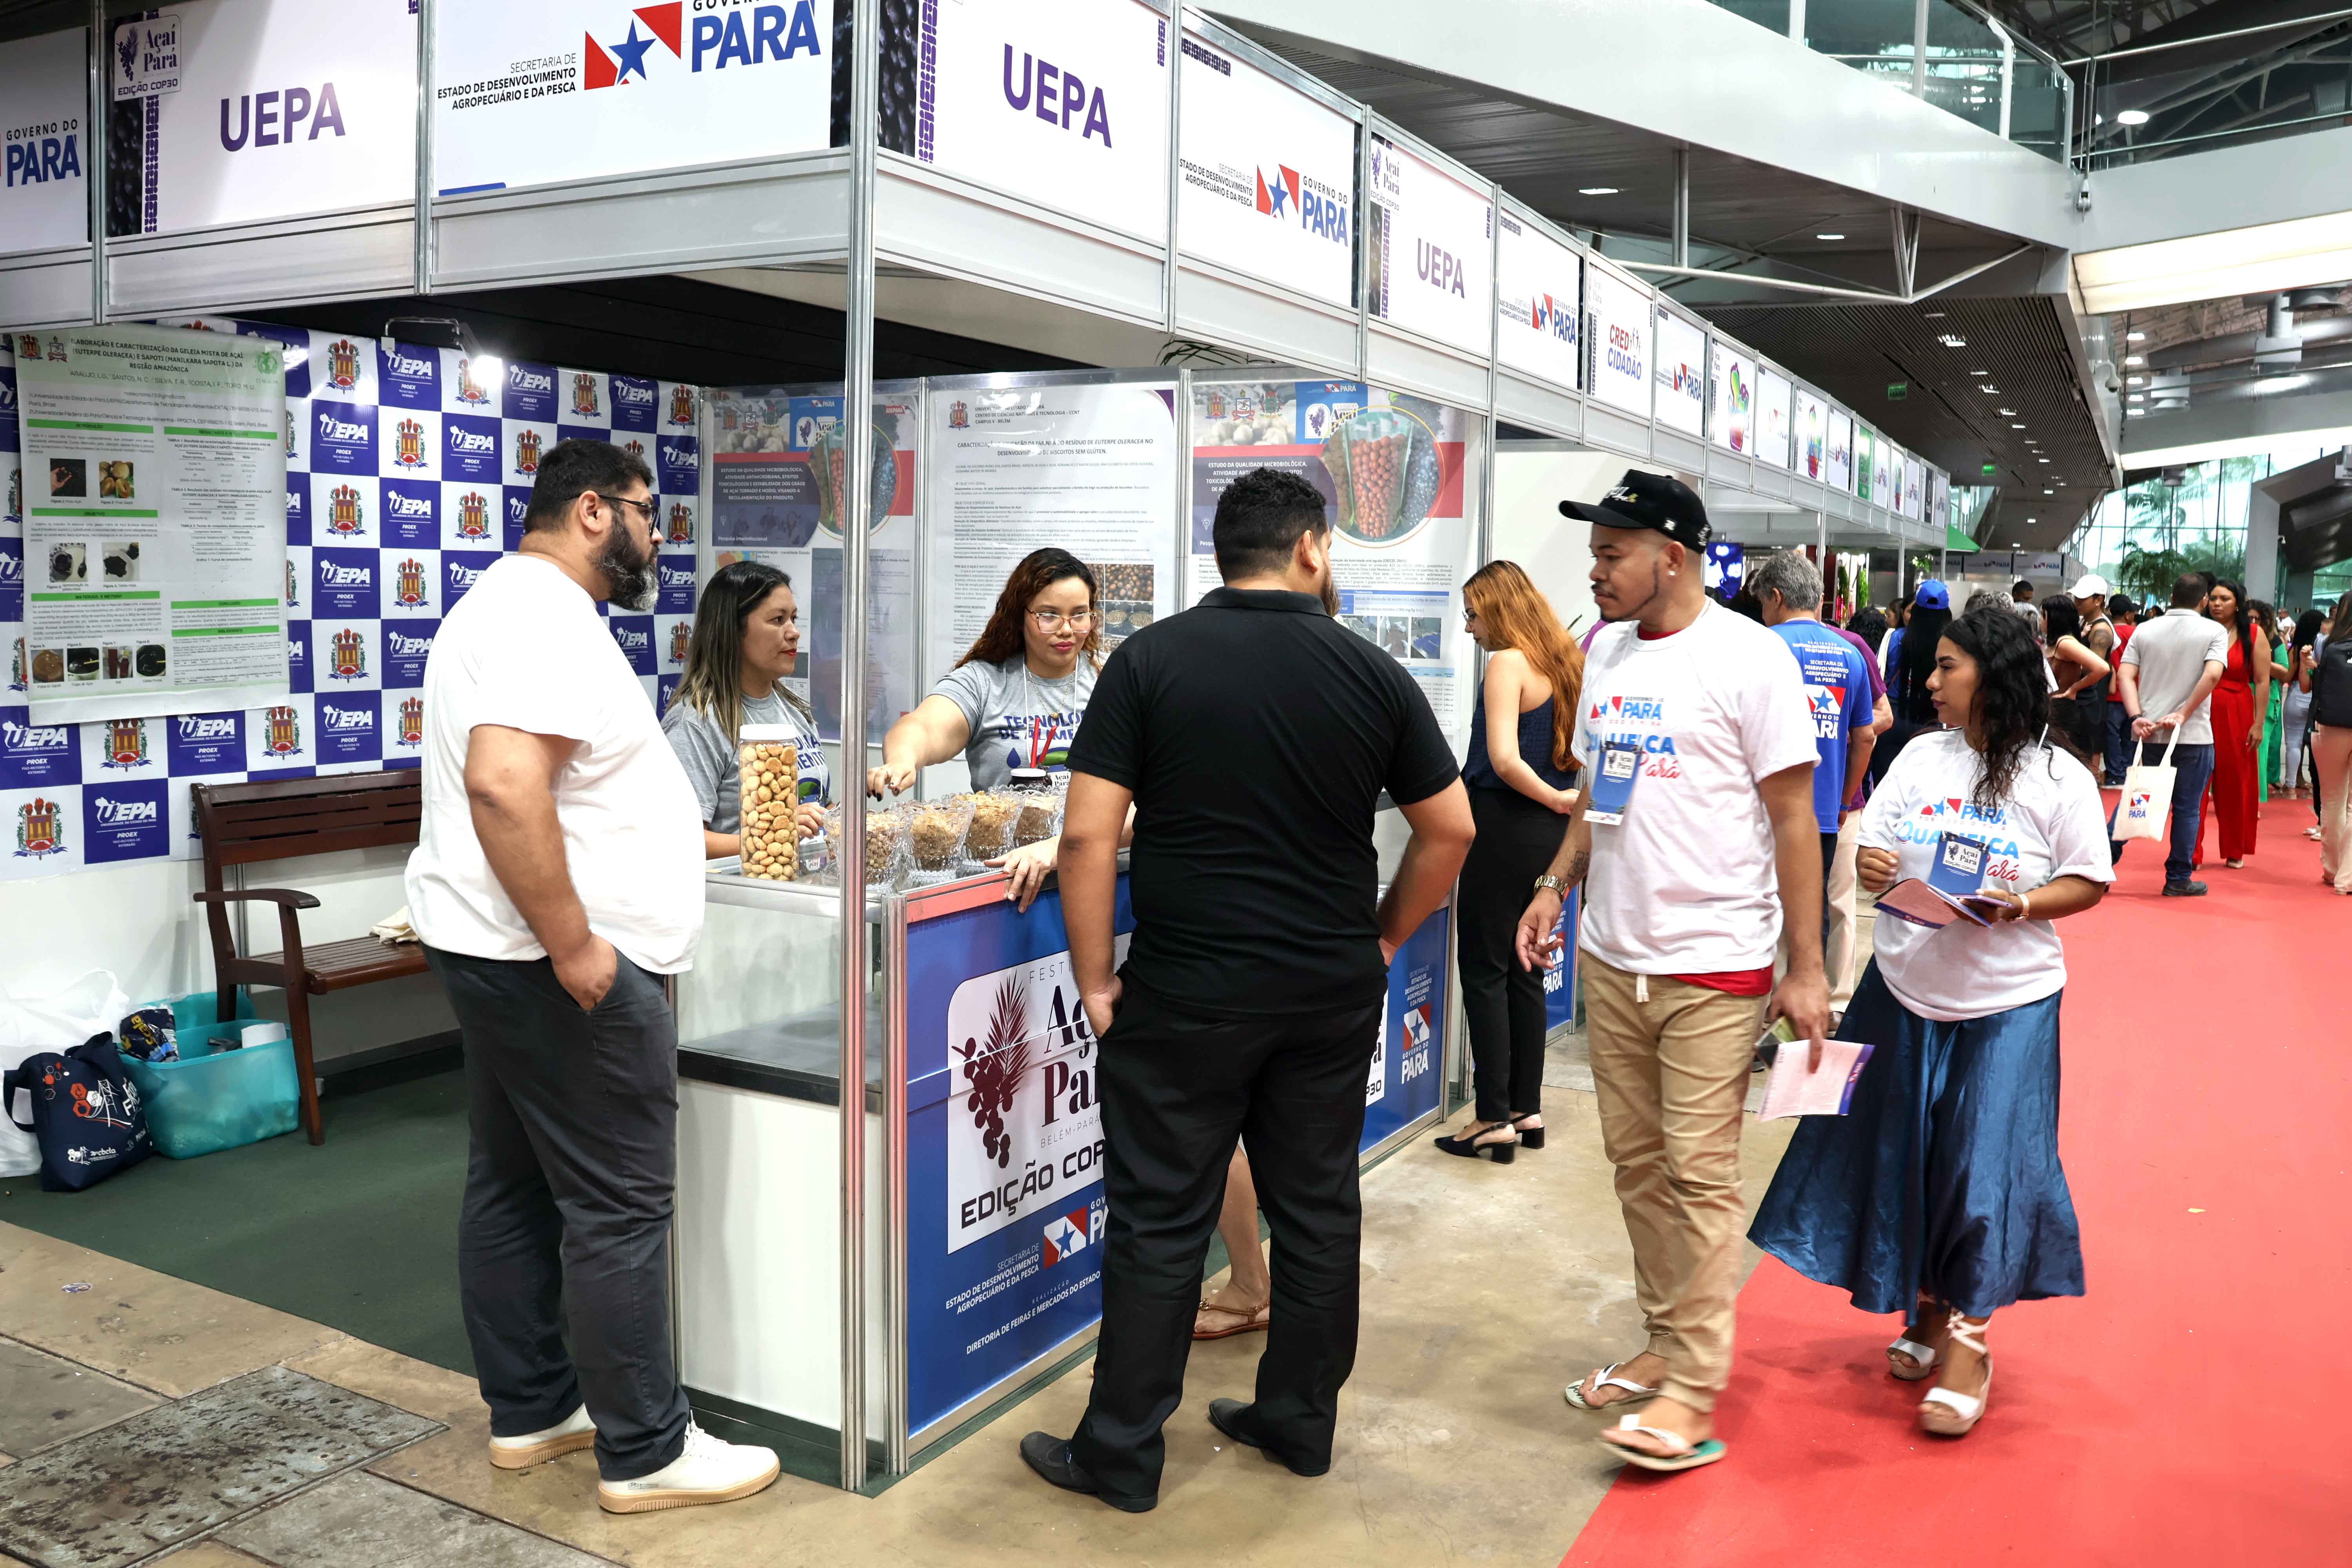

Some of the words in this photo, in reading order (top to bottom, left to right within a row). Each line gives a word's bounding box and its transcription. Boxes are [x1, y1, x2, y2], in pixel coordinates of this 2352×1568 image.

[144, 24, 175, 53] Açaí
[692, 0, 821, 73] PARÁ
[143, 47, 177, 72] Pará
[510, 56, 562, 73] SECRETARIA
[564, 53, 576, 64] DE
[118, 81, 148, 96] EDIÇÃO
[151, 78, 178, 90] COP30
[438, 85, 471, 98] ESTADO
[474, 82, 485, 93] DE
[488, 67, 576, 91] DESENVOLVIMENTO
[452, 90, 521, 110] AGROPECUÁRIO
[524, 89, 529, 98] E
[532, 87, 544, 98] DA
[547, 82, 576, 95] PESCA
[1003, 43, 1112, 149] UEPA
[220, 83, 345, 151] UEPA
[7, 123, 57, 141] GOVERNO
[63, 119, 78, 131] DO
[7, 134, 81, 187] PARÁ
[1384, 155, 1399, 178] Açaí
[1180, 158, 1197, 172] STADO
[1198, 167, 1205, 176] DE
[1206, 170, 1252, 196] DESENVOLVIMENTO
[1219, 163, 1246, 183] SECRETARIA
[1247, 176, 1253, 185] DE
[1383, 173, 1399, 196] Pará
[1186, 173, 1225, 196] AGROPECUÁRIO
[1230, 192, 1237, 201] DA
[1238, 195, 1252, 207] PESCA
[1303, 176, 1335, 198] GOVERNO
[1339, 192, 1347, 204] DO
[1370, 190, 1385, 203] EDIÇÃO
[1386, 199, 1399, 211] COP30
[1303, 189, 1348, 247] PARÁ
[1417, 238, 1465, 299] UEPA
[1554, 299, 1570, 312] GOVERNO
[71, 338, 109, 348] ELABORAÇÃO
[116, 342, 169, 353] CARACTERIZAÇÃO
[1610, 324, 1629, 351] CRED
[73, 348, 102, 357] (EUTERPE
[103, 350, 135, 360] OLERACEA)
[165, 356, 202, 365] (MANILKARA
[130, 362, 152, 370] REGIÃO
[154, 364, 189, 373] AMAZÔNICA
[388, 352, 432, 376] UEPA
[1608, 347, 1642, 380] CIDADÃO
[321, 418, 368, 441] UEPA
[390, 494, 431, 515] UEPA
[321, 564, 370, 583] UEPA
[1805, 665, 1849, 673] DESENVOLVIMENTO
[180, 716, 235, 738] UEPA
[324, 708, 372, 730] UEPA
[1004, 711, 1085, 728] TECNOLO
[5, 725, 67, 748] UEPA
[999, 729, 1020, 740] DE
[97, 801, 156, 822] UEPA
[1960, 855, 1977, 866] Pará
[1962, 848, 1978, 858] Açaí
[1405, 978, 1432, 995] DESENVOLVIMENTO
[1412, 975, 1421, 984] ESTADO
[1407, 986, 1429, 1001] AGROPECUÁRIO
[1417, 995, 1426, 1004] PESCA
[1044, 985, 1096, 1059] Aç
[1403, 1044, 1421, 1060] GOVERNO
[962, 1159, 1053, 1229] EDIÇÃO
[1063, 1139, 1105, 1179] COP
[998, 1249, 1030, 1272] SECRETARIA
[1032, 1242, 1039, 1255] DE
[946, 1290, 971, 1310] ESTADO
[973, 1284, 980, 1295] DE
[982, 1254, 1039, 1290] DESENVOLVIMENTO
[957, 1281, 1005, 1315] AGROPECUÁRIO
[1007, 1278, 1010, 1287] E
[1011, 1274, 1020, 1285] DA
[1021, 1264, 1039, 1279] PESCA
[1032, 1279, 1069, 1304] REALIZAÇÃO
[967, 1328, 1000, 1354] DIRETORIA
[1002, 1323, 1010, 1335] DE
[1011, 1312, 1031, 1329] FEIRAS
[1032, 1307, 1036, 1317] E
[1037, 1291, 1069, 1315] MERCADOS
[1070, 1285, 1078, 1296] DO
[1079, 1270, 1101, 1289] ESTADO
